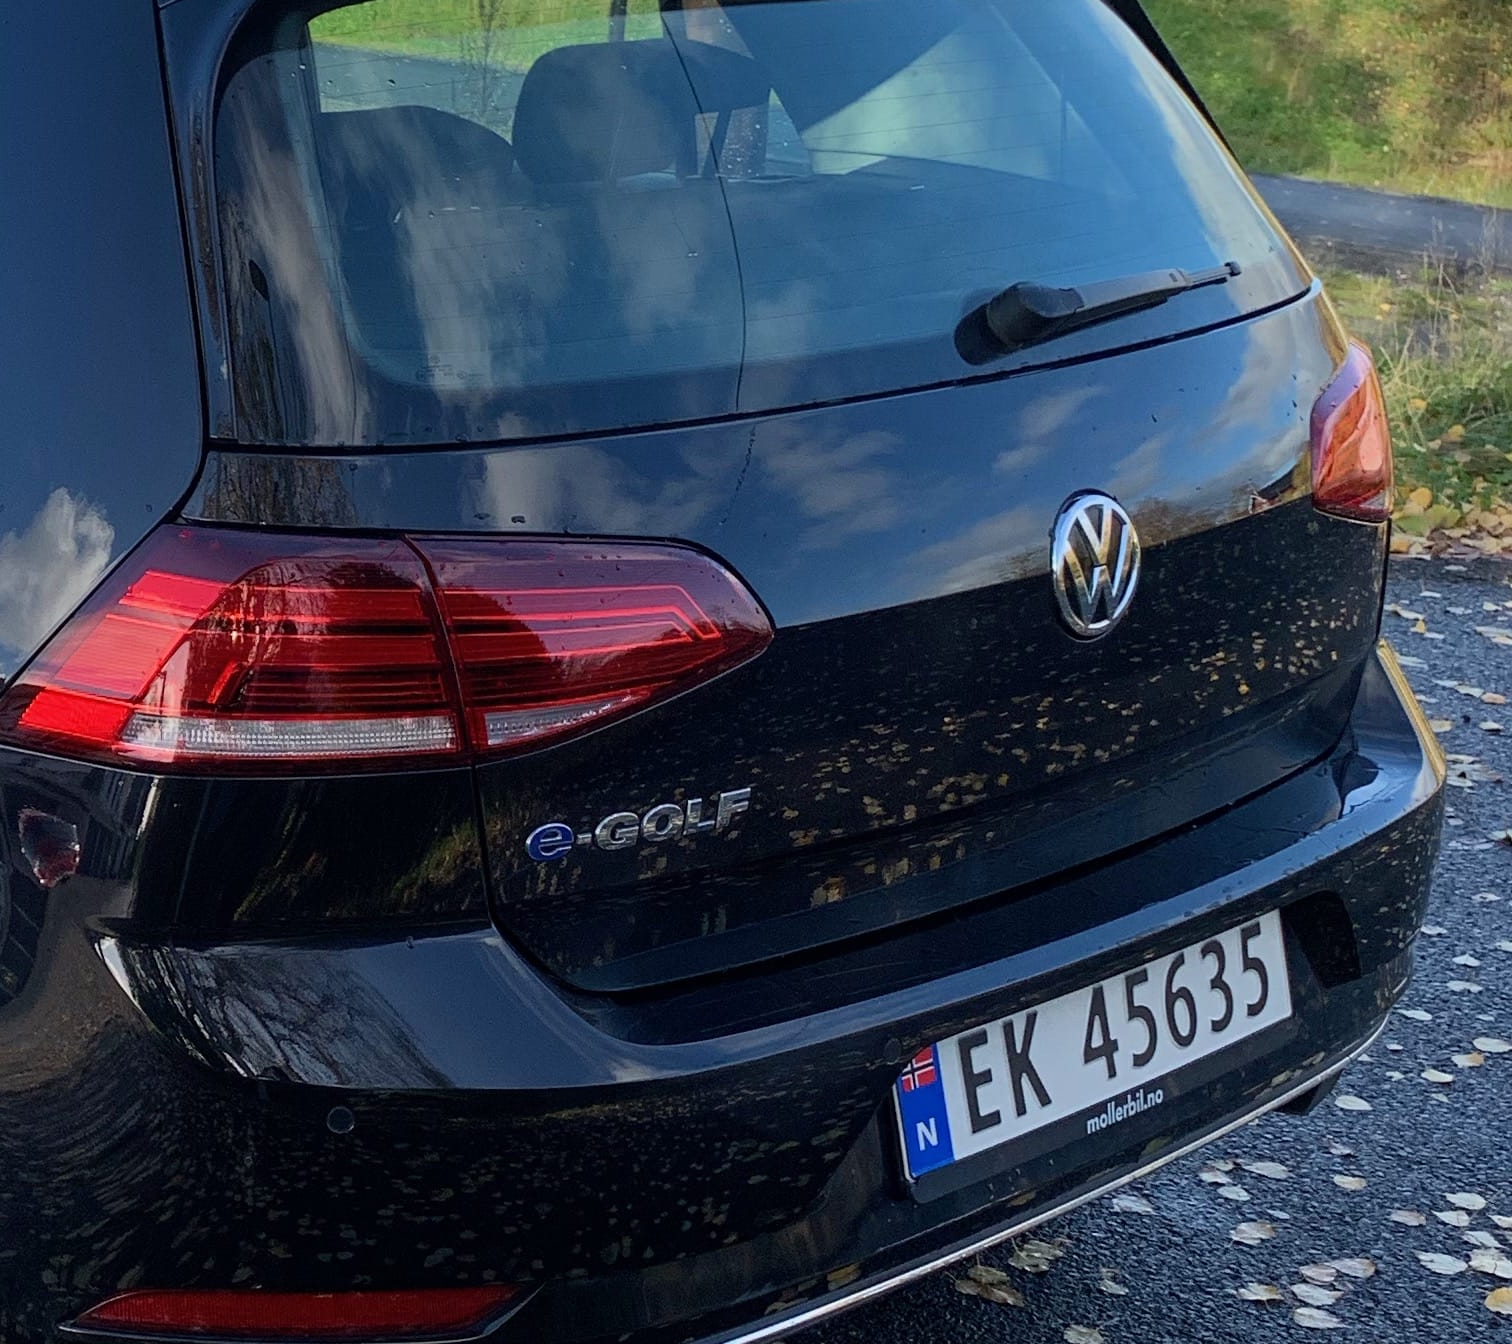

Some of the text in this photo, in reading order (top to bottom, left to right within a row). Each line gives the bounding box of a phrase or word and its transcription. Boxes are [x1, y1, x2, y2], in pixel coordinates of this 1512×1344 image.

[525, 787, 751, 861] e-GOLF
[958, 921, 1270, 1134] EK 45635
[916, 1117, 938, 1151] N
[1087, 1088, 1164, 1134] mollerbil.no
